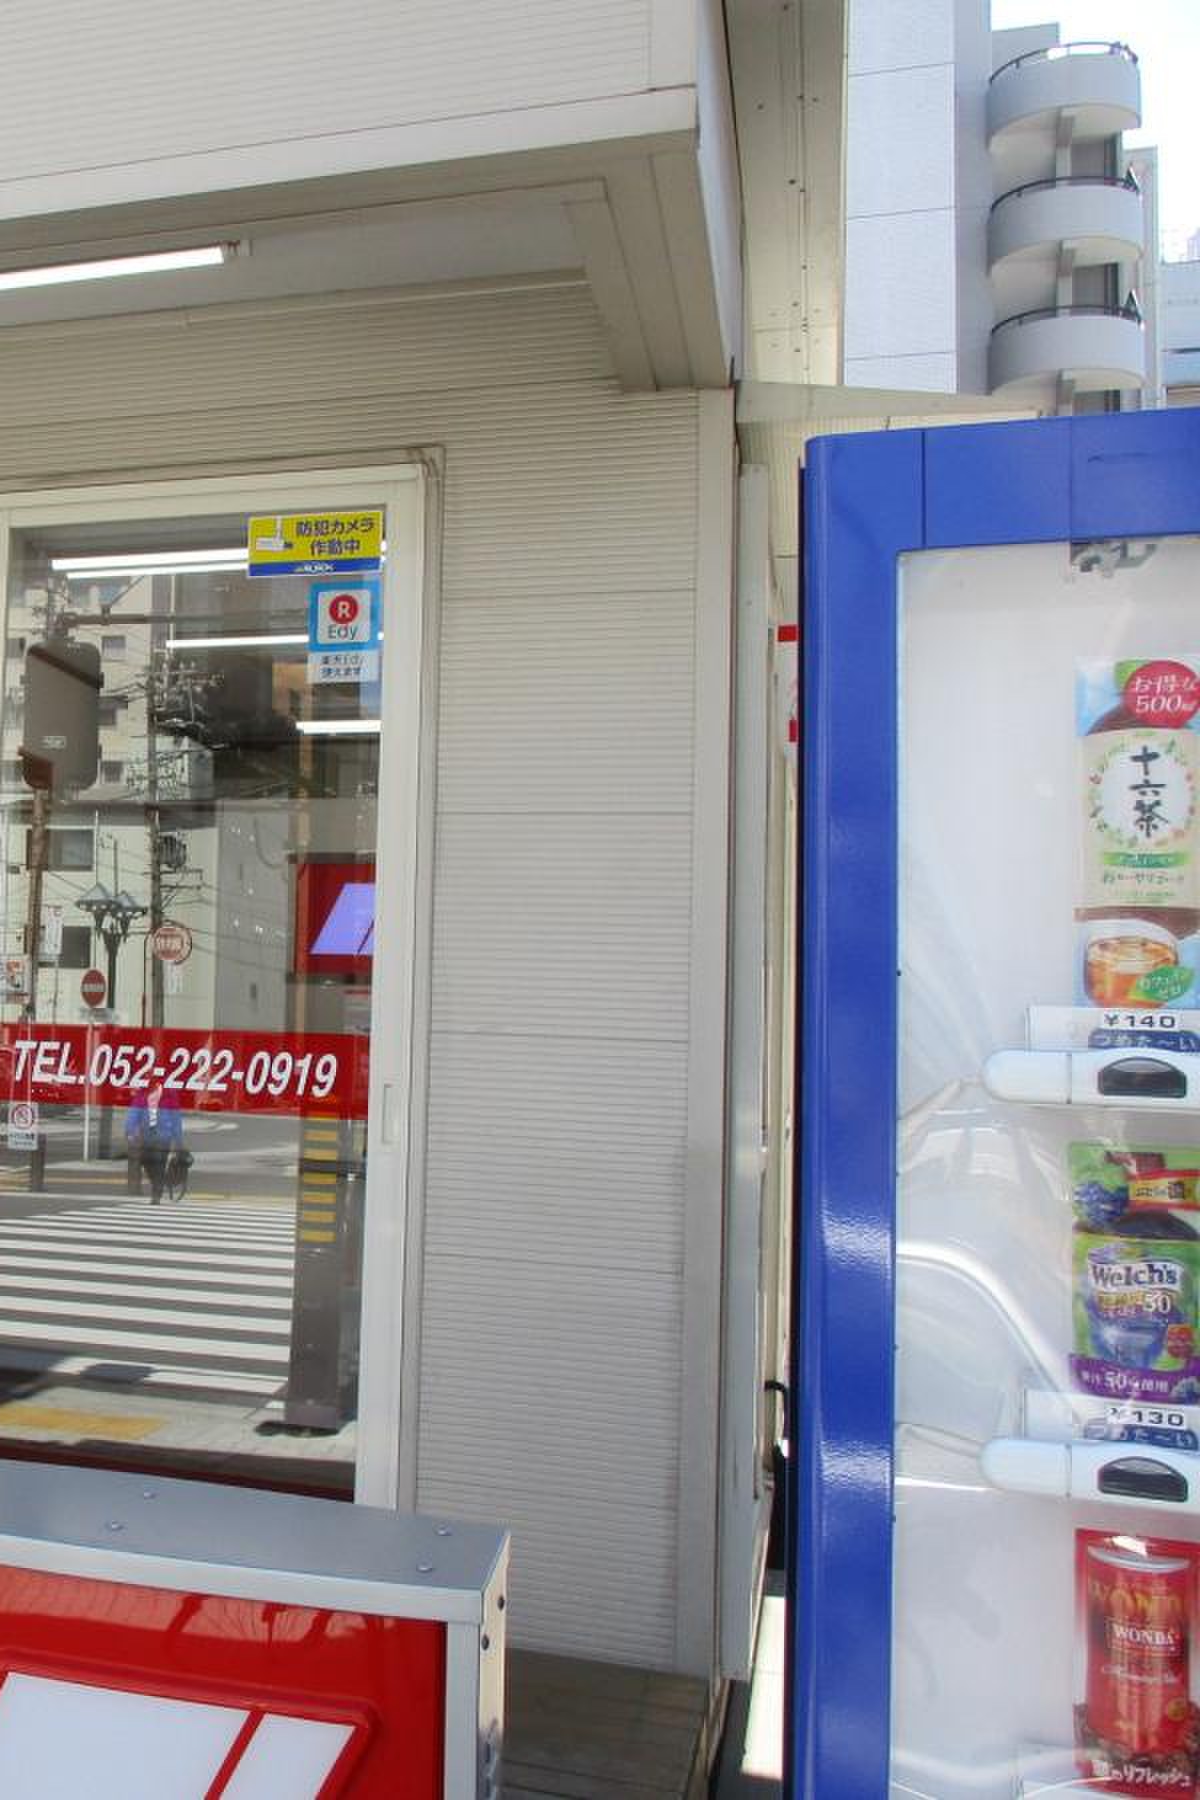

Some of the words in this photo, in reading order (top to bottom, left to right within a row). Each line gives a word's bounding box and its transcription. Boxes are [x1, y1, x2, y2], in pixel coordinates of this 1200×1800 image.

[296, 517, 376, 538] 防犯カメラ
[310, 539, 361, 557] 作動中
[327, 624, 359, 641] Edy
[1128, 744, 1170, 838] 十六茶
[1104, 1014, 1176, 1028] ¥140
[13, 1039, 338, 1099] TEL.052-222-0919
[1091, 1263, 1177, 1286] Welch's
